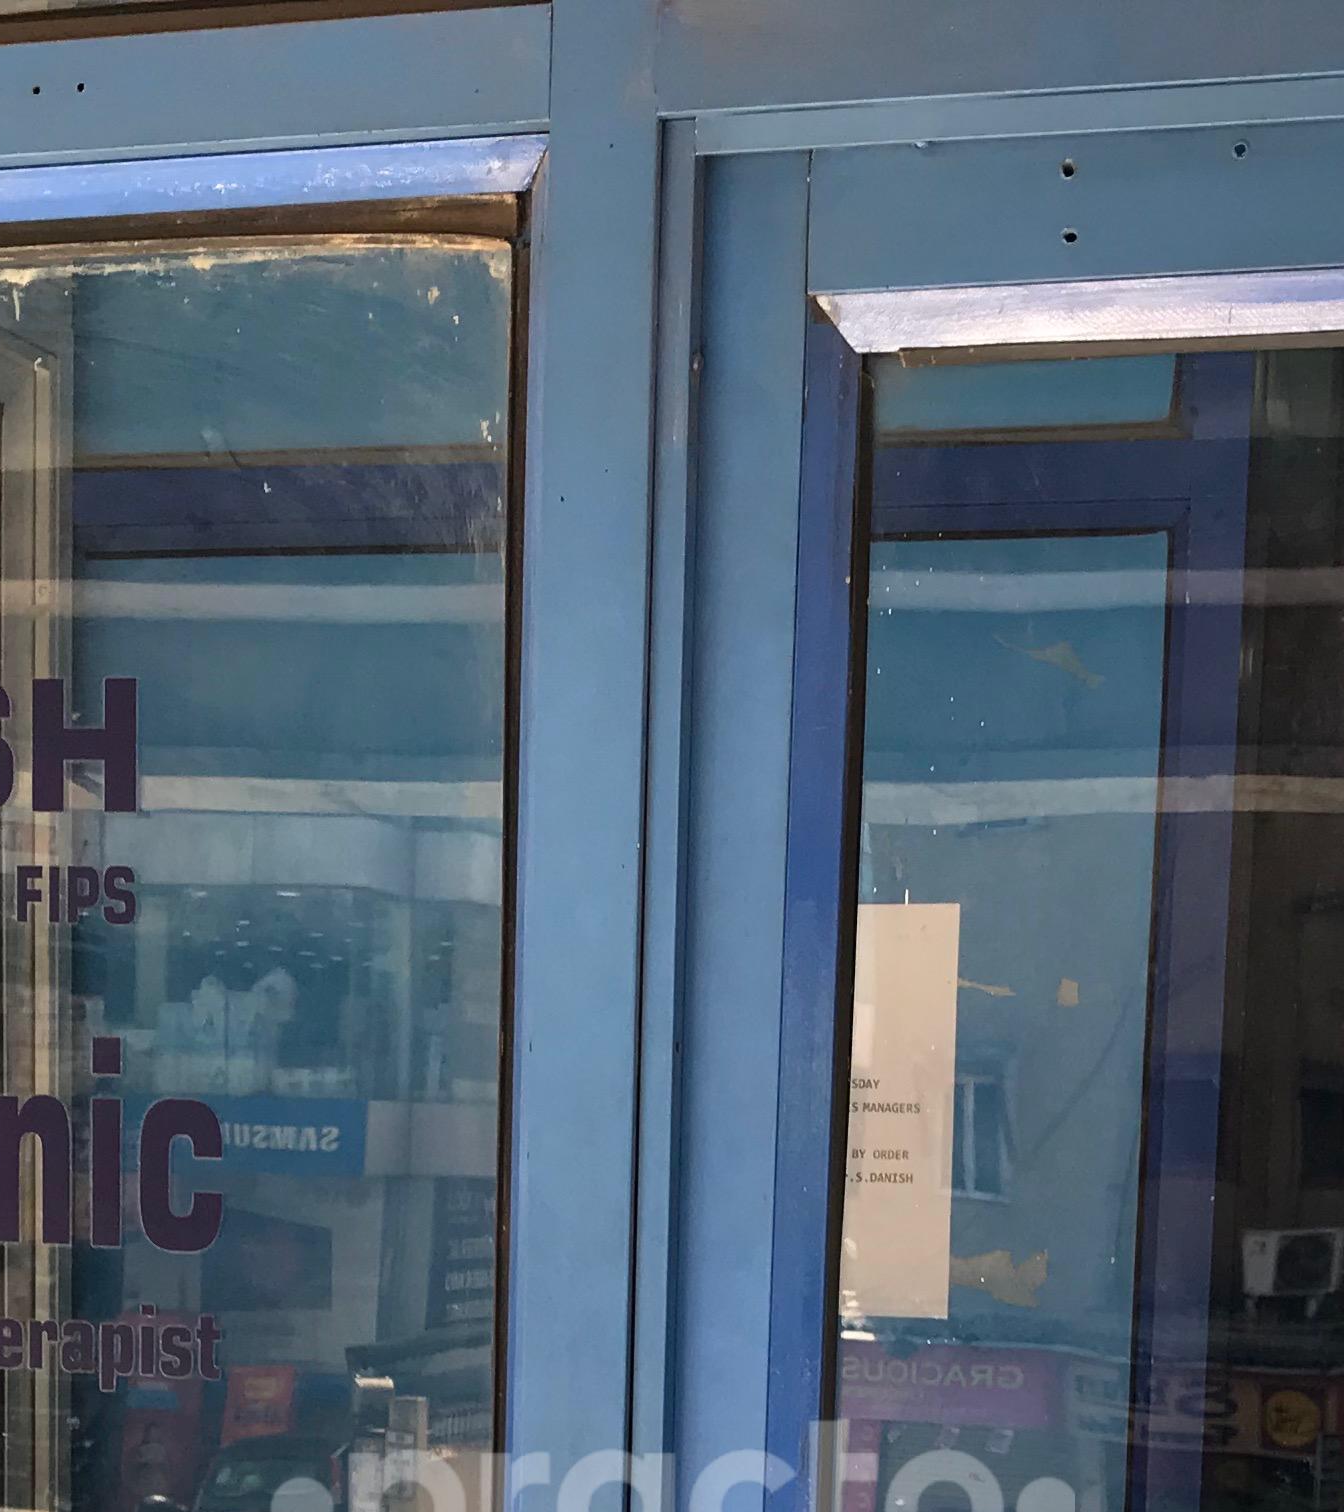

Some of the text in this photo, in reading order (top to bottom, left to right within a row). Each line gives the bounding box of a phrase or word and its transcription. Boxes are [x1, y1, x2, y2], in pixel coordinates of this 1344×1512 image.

[15, 866, 138, 926] FIPS
[849, 1078, 881, 1090] SDAY
[862, 1102, 922, 1115] MANAGERS
[851, 1147, 910, 1161] BY ORDER
